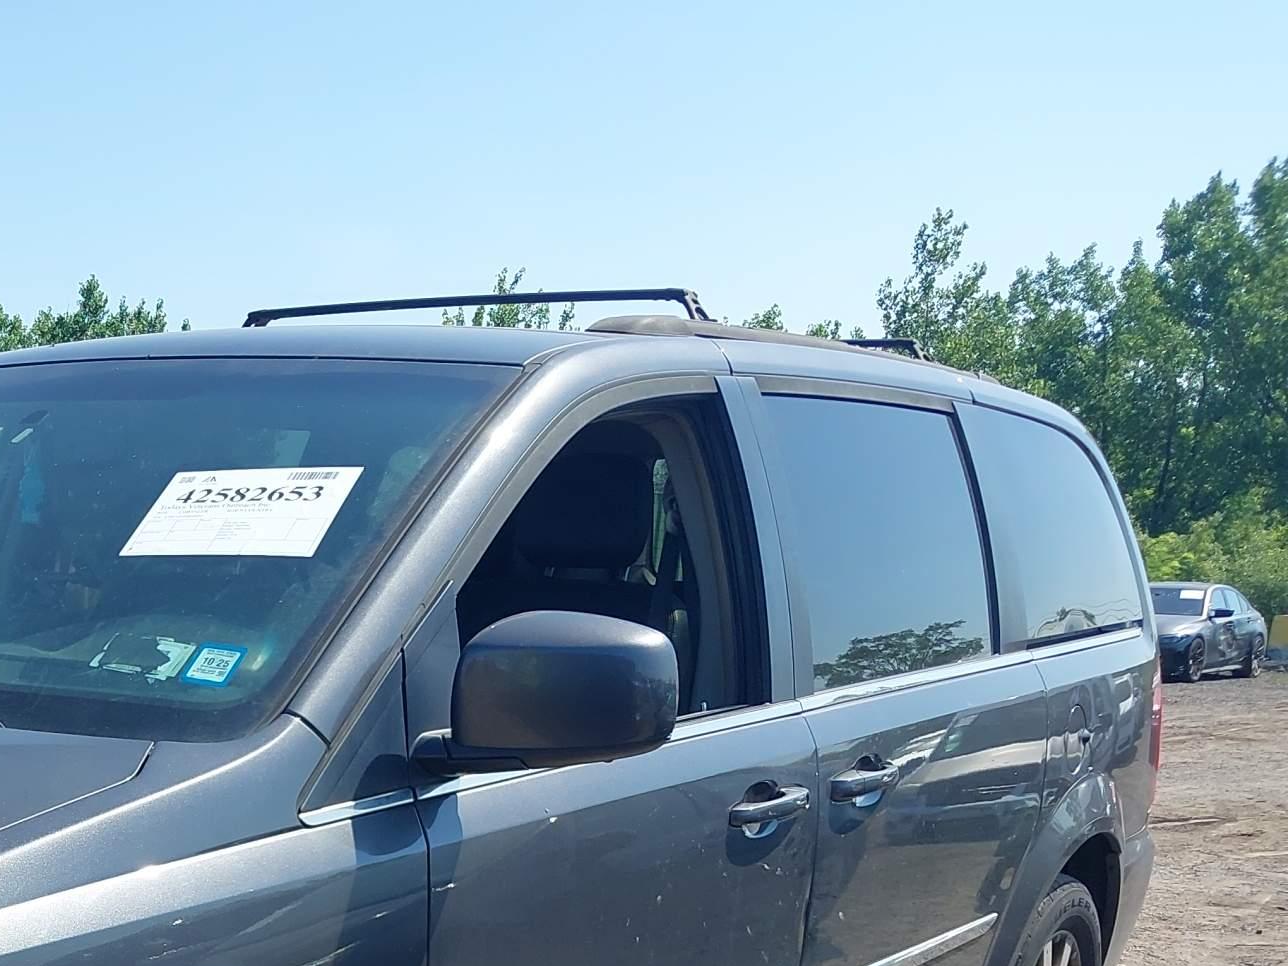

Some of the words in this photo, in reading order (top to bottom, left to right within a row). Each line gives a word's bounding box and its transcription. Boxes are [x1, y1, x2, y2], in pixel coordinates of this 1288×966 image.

[176, 485, 324, 504] 42582653
[202, 657, 215, 666] 10
[216, 659, 230, 668] 25
